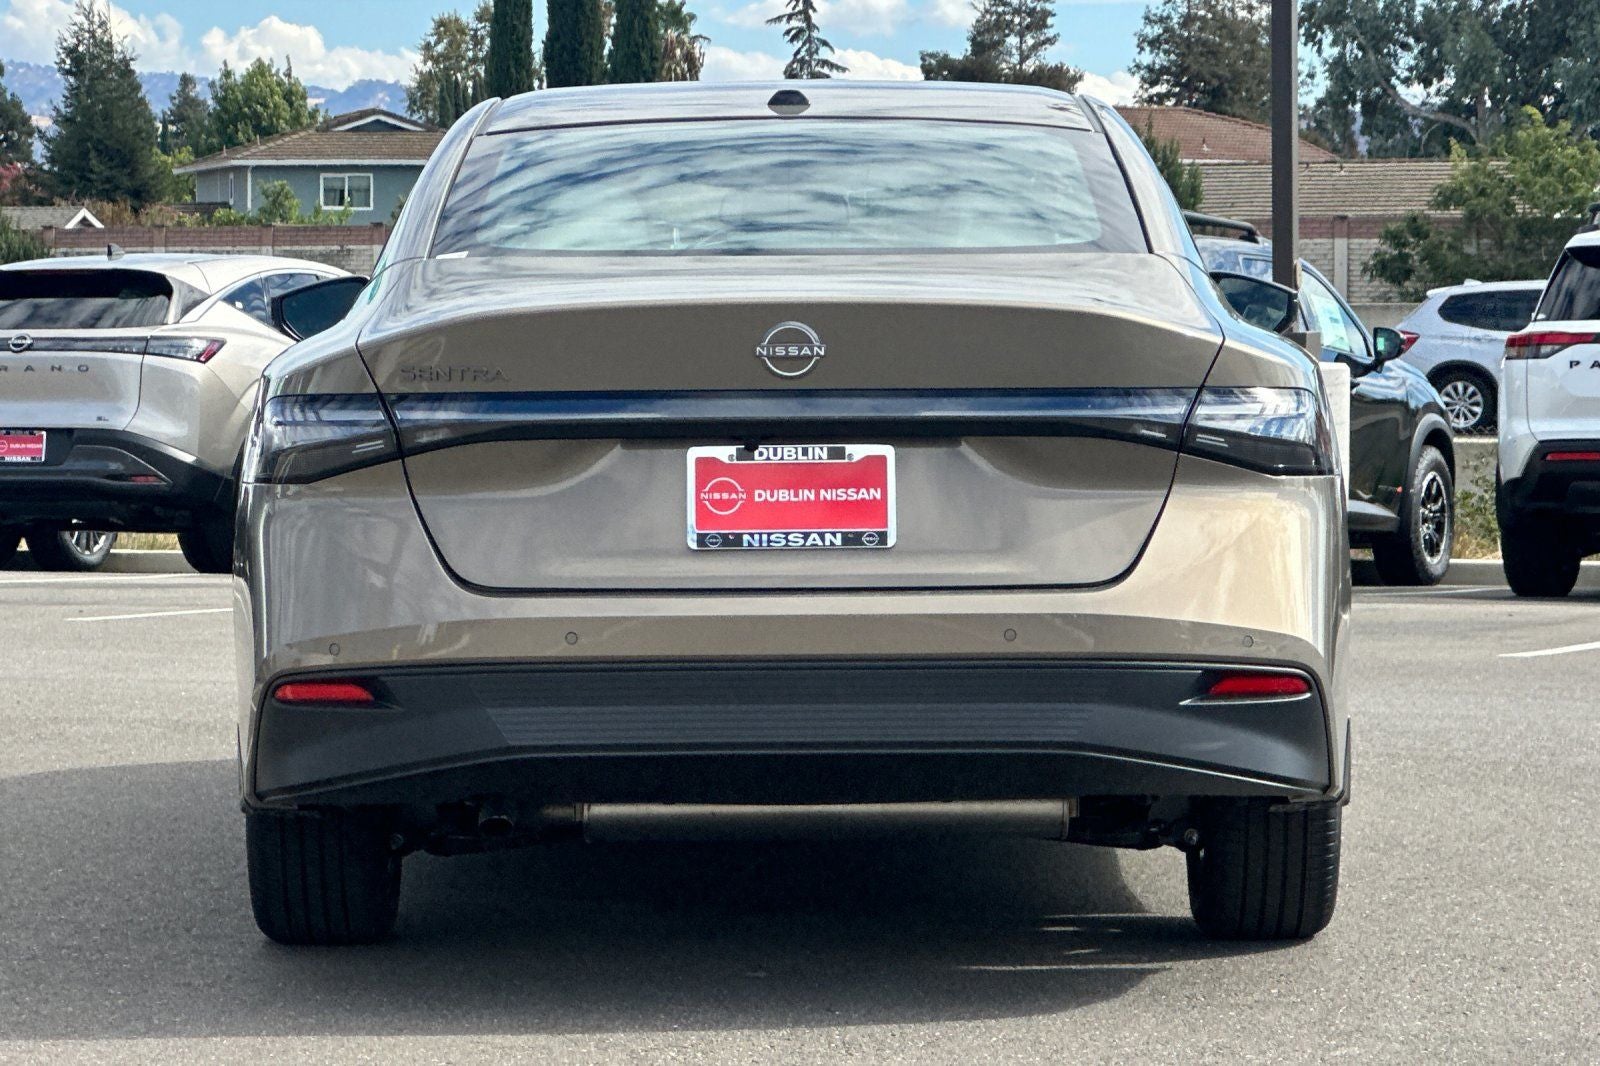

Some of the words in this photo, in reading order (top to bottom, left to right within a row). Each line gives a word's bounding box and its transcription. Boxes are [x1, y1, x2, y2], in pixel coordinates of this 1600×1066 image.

[756, 346, 825, 356] NISSAN
[400, 366, 512, 381] SENTRA
[754, 446, 828, 460] DUBLIN
[700, 491, 747, 500] NISSAN
[754, 488, 815, 502] DUBLIN
[820, 487, 881, 500] NISSAN
[742, 532, 842, 547] NISSAN
